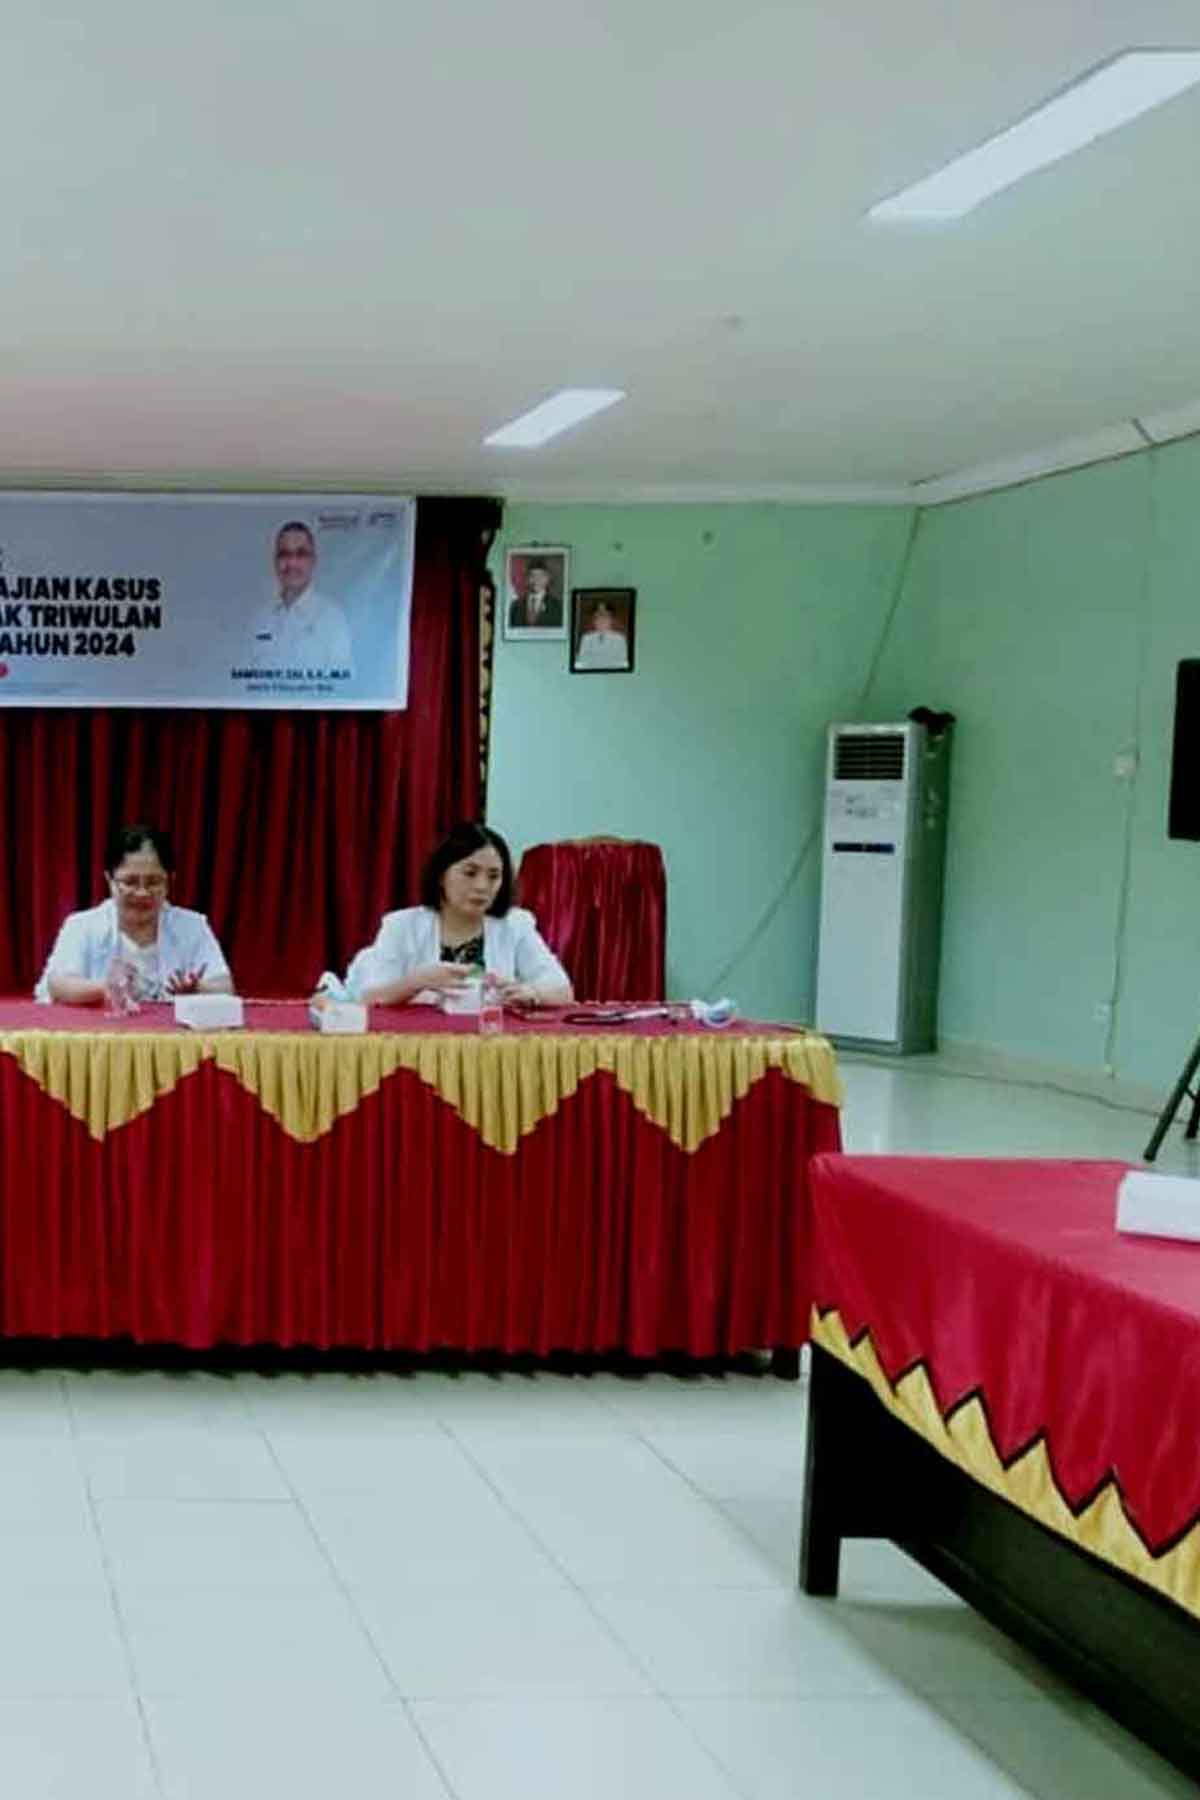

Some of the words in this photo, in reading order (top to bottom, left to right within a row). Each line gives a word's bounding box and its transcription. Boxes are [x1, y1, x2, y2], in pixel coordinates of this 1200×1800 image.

[75, 577, 161, 601] KASUS
[28, 605, 161, 629] TRIWULAN
[74, 633, 136, 656] 2024
